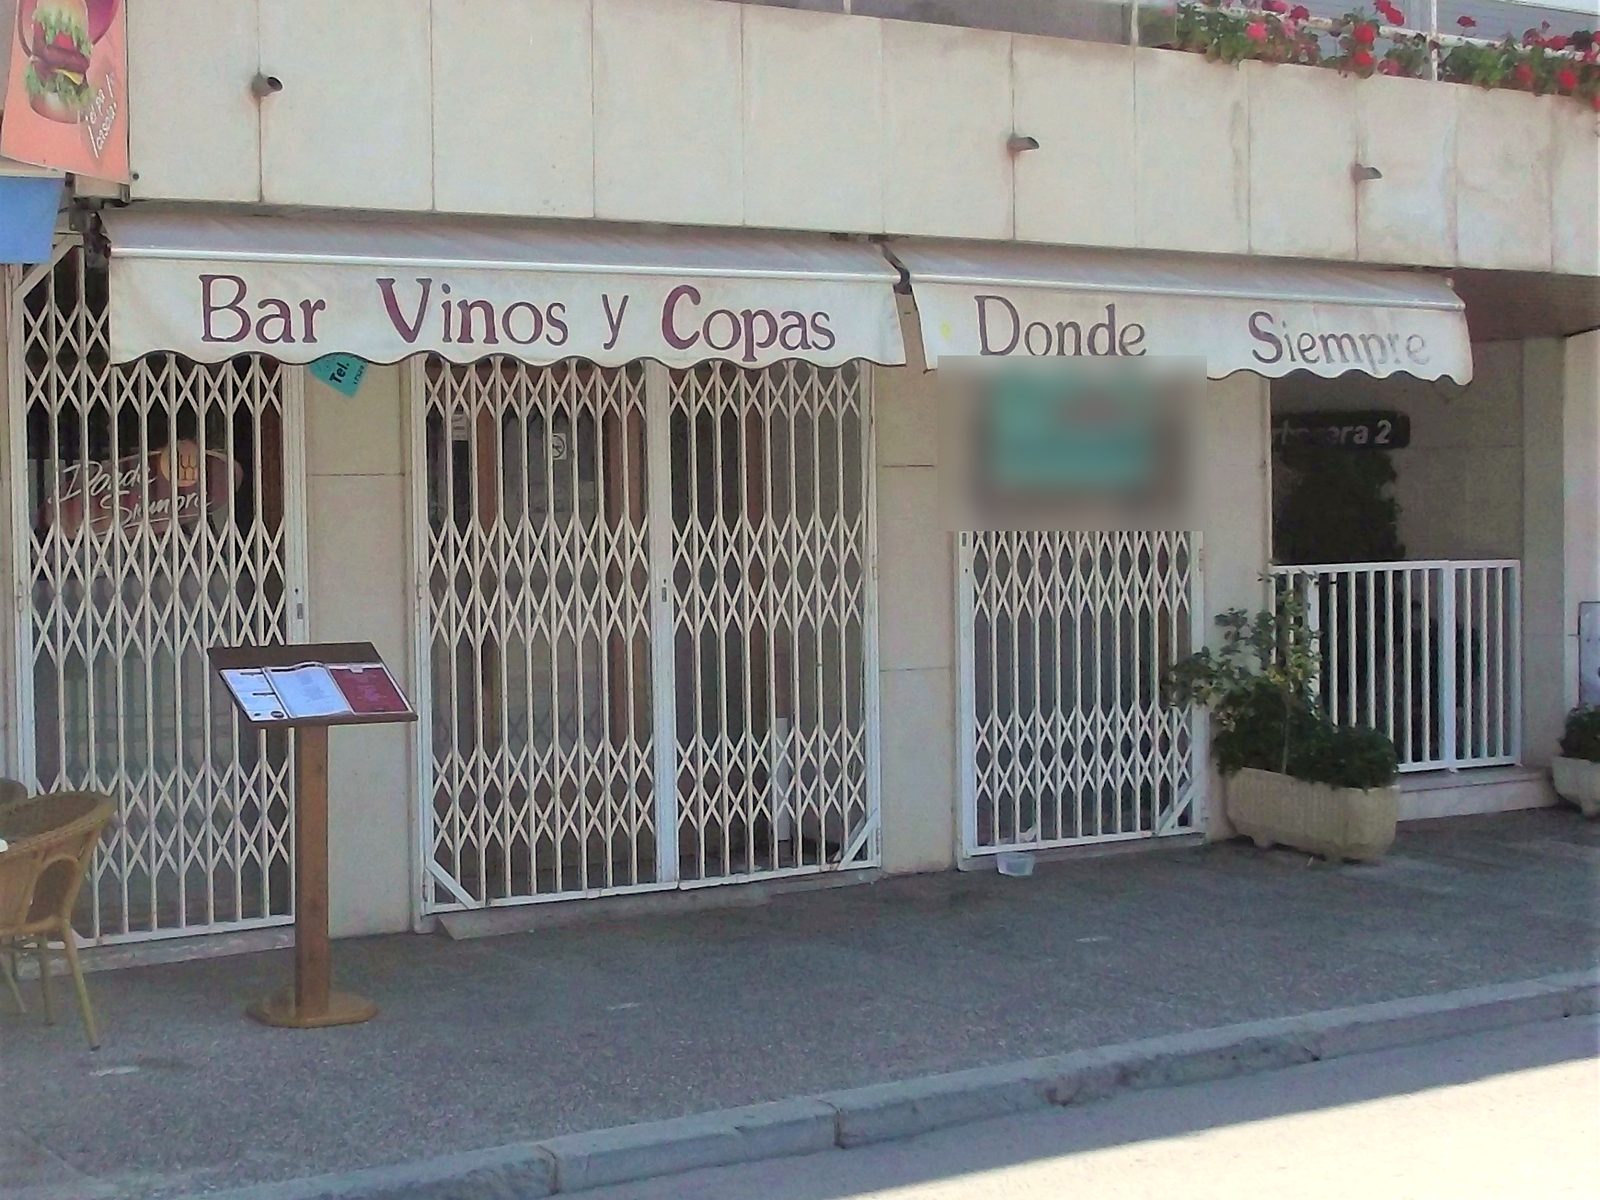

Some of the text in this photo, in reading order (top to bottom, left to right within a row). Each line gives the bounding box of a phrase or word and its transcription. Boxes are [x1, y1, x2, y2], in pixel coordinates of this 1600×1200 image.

[199, 274, 836, 363] Bar Vinos y Copas
[974, 295, 1430, 375] Donde Siempre
[329, 361, 350, 384] Tel.
[1374, 419, 1392, 444] 2
